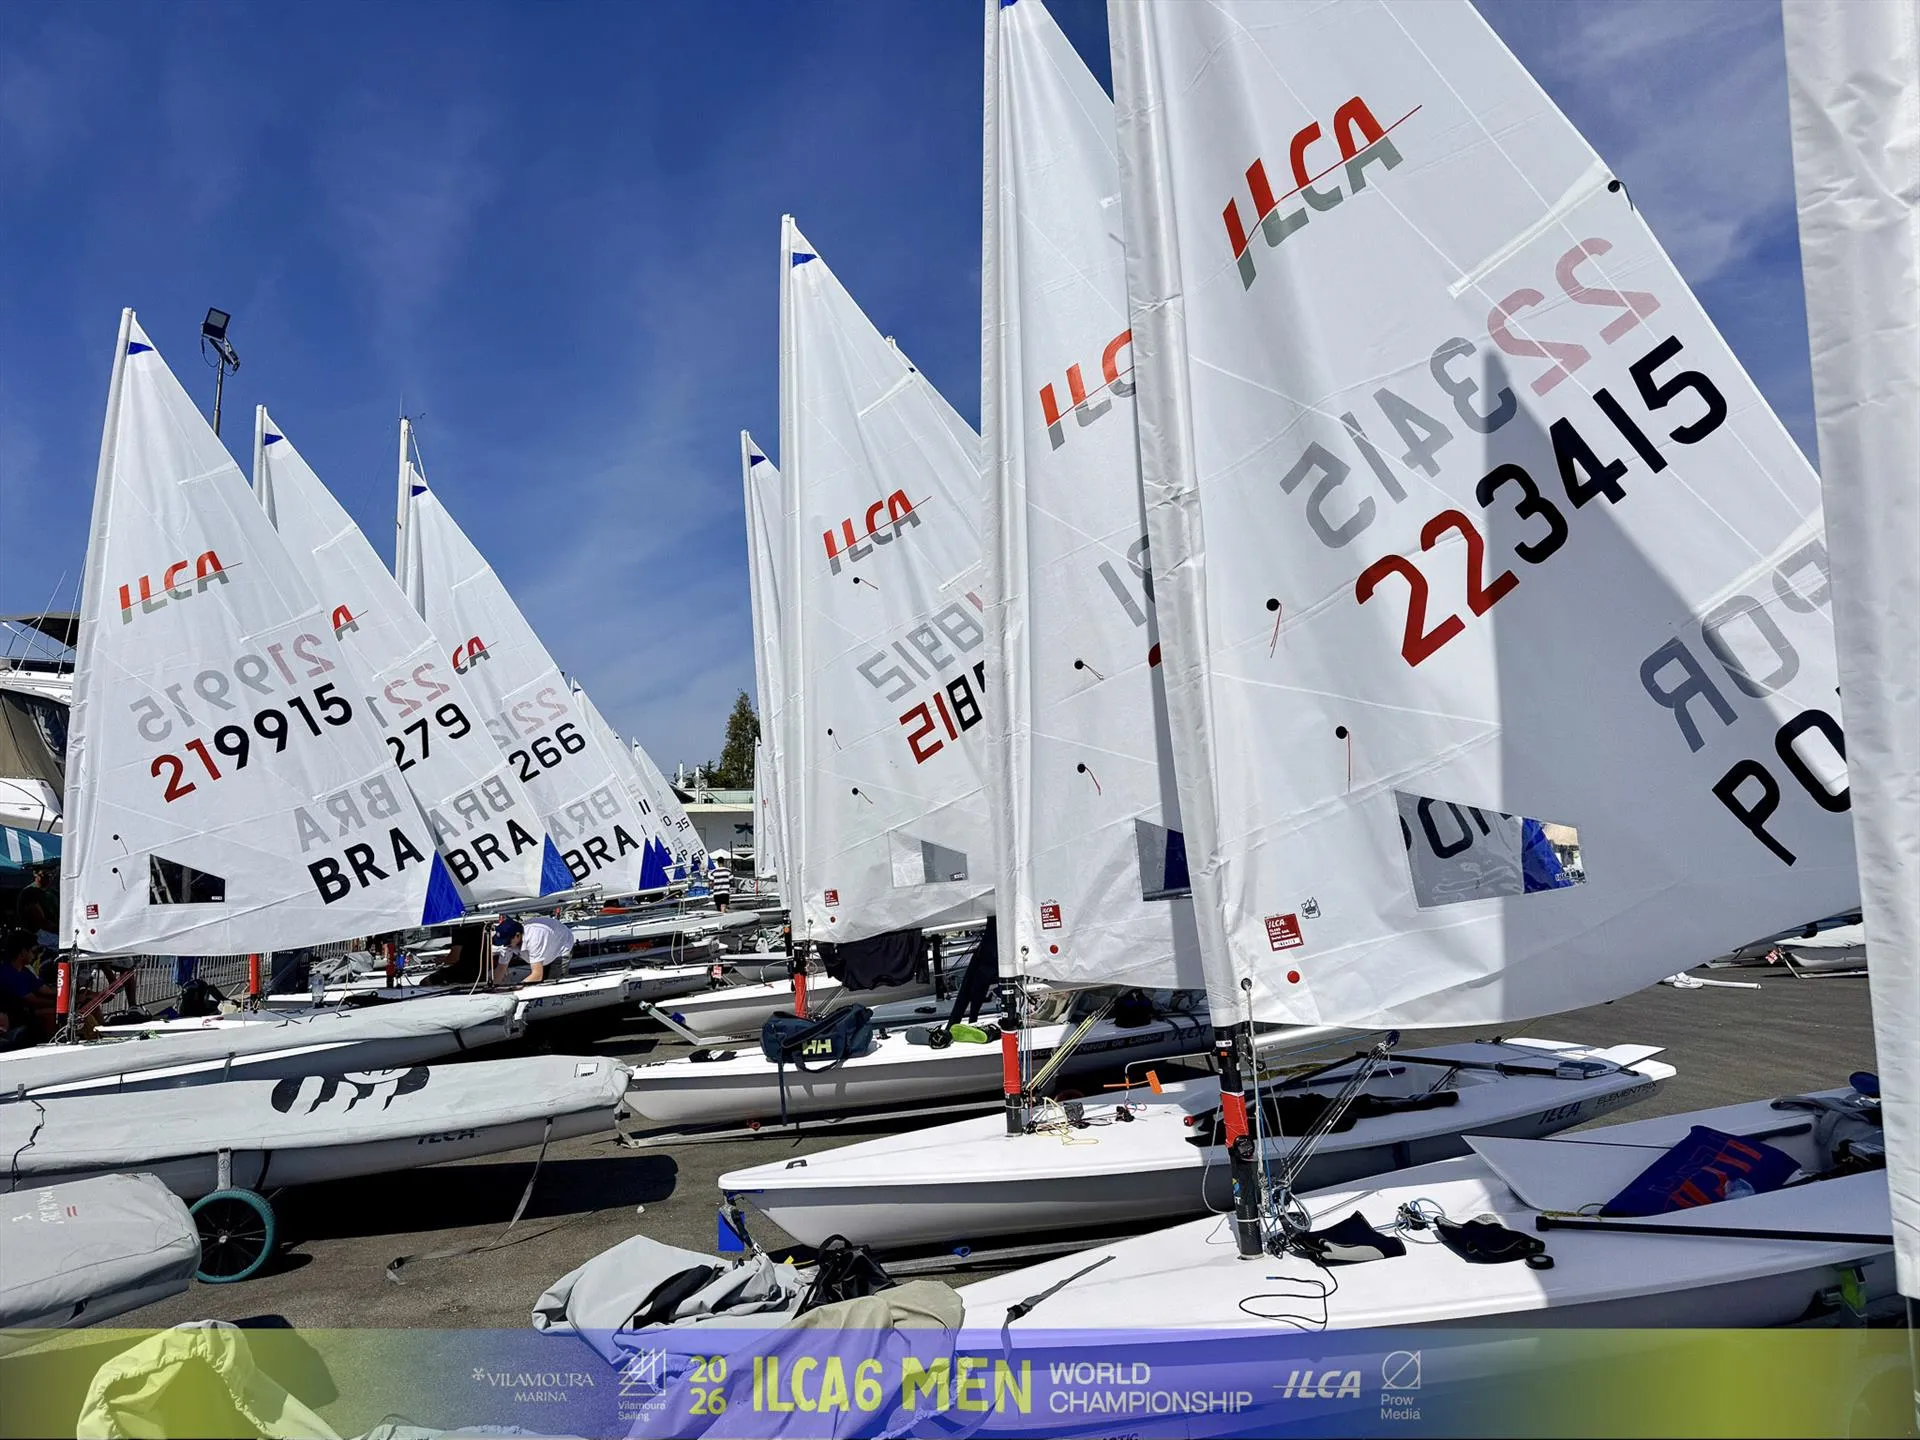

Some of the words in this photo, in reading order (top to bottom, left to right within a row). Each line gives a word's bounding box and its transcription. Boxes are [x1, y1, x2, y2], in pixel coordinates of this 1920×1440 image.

[1222, 96, 1405, 292] ILCA
[1039, 328, 1136, 451] ILC
[822, 488, 923, 577] ILCA
[1355, 334, 1728, 667] 223415
[118, 550, 232, 625] ILCA
[452, 636, 491, 675] CA
[150, 682, 353, 803] 219915
[386, 702, 471, 773] 279
[898, 659, 984, 765] 218
[508, 722, 586, 783] 266
[1712, 687, 1853, 867] PO
[307, 827, 426, 904] BRA
[444, 818, 539, 886] BRA
[562, 824, 640, 882] BRA
[802, 1038, 832, 1055] HH
